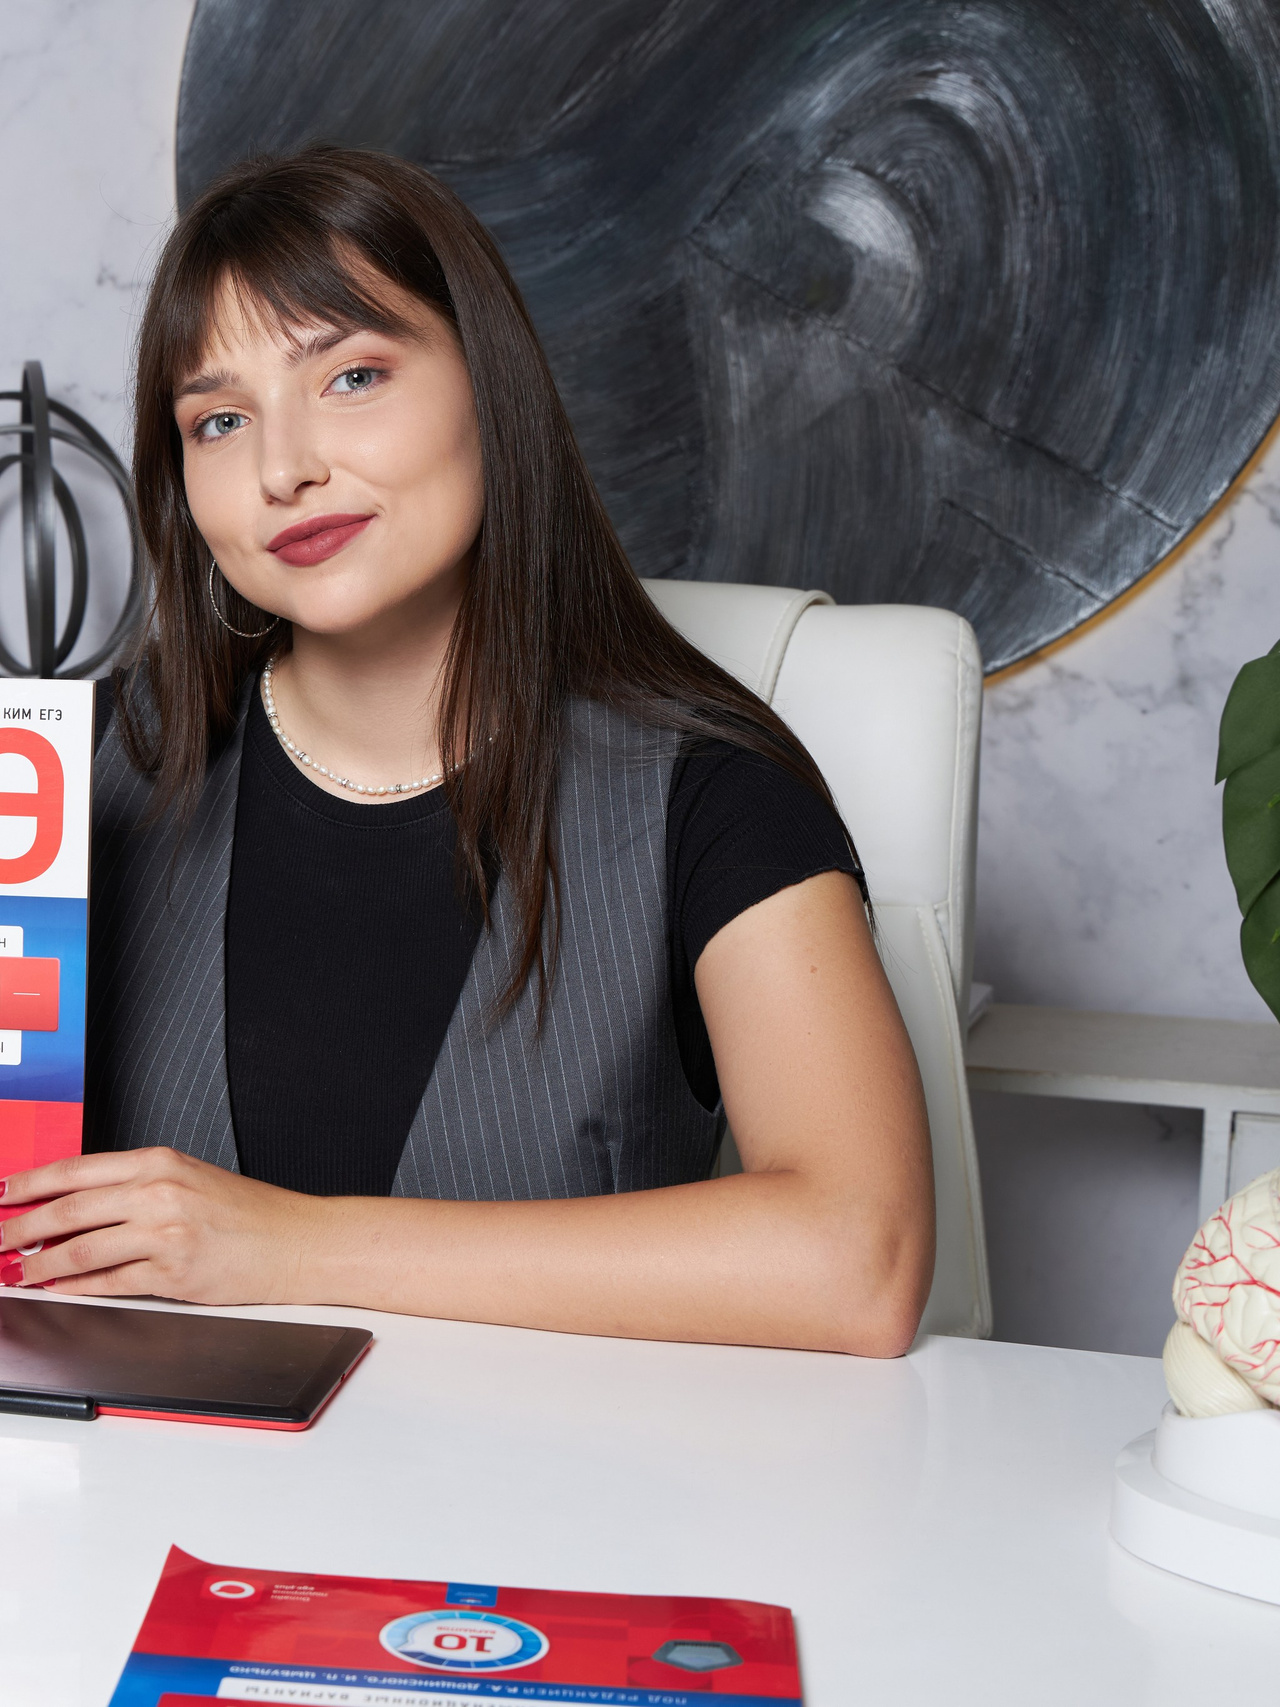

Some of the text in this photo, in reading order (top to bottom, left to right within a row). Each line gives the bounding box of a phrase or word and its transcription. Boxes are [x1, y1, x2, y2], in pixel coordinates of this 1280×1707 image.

[4, 707, 32, 720] КИМ
[39, 708, 63, 721] ЕГЭ
[433, 1633, 494, 1653] 10
[229, 1665, 316, 1680] ЦЫБУЛЬКО
[246, 1685, 350, 1700] ВАРИАНТЫ
[523, 1686, 639, 1702] РЕДАКЦИЕЙ
[648, 1694, 688, 1706] ПОД
